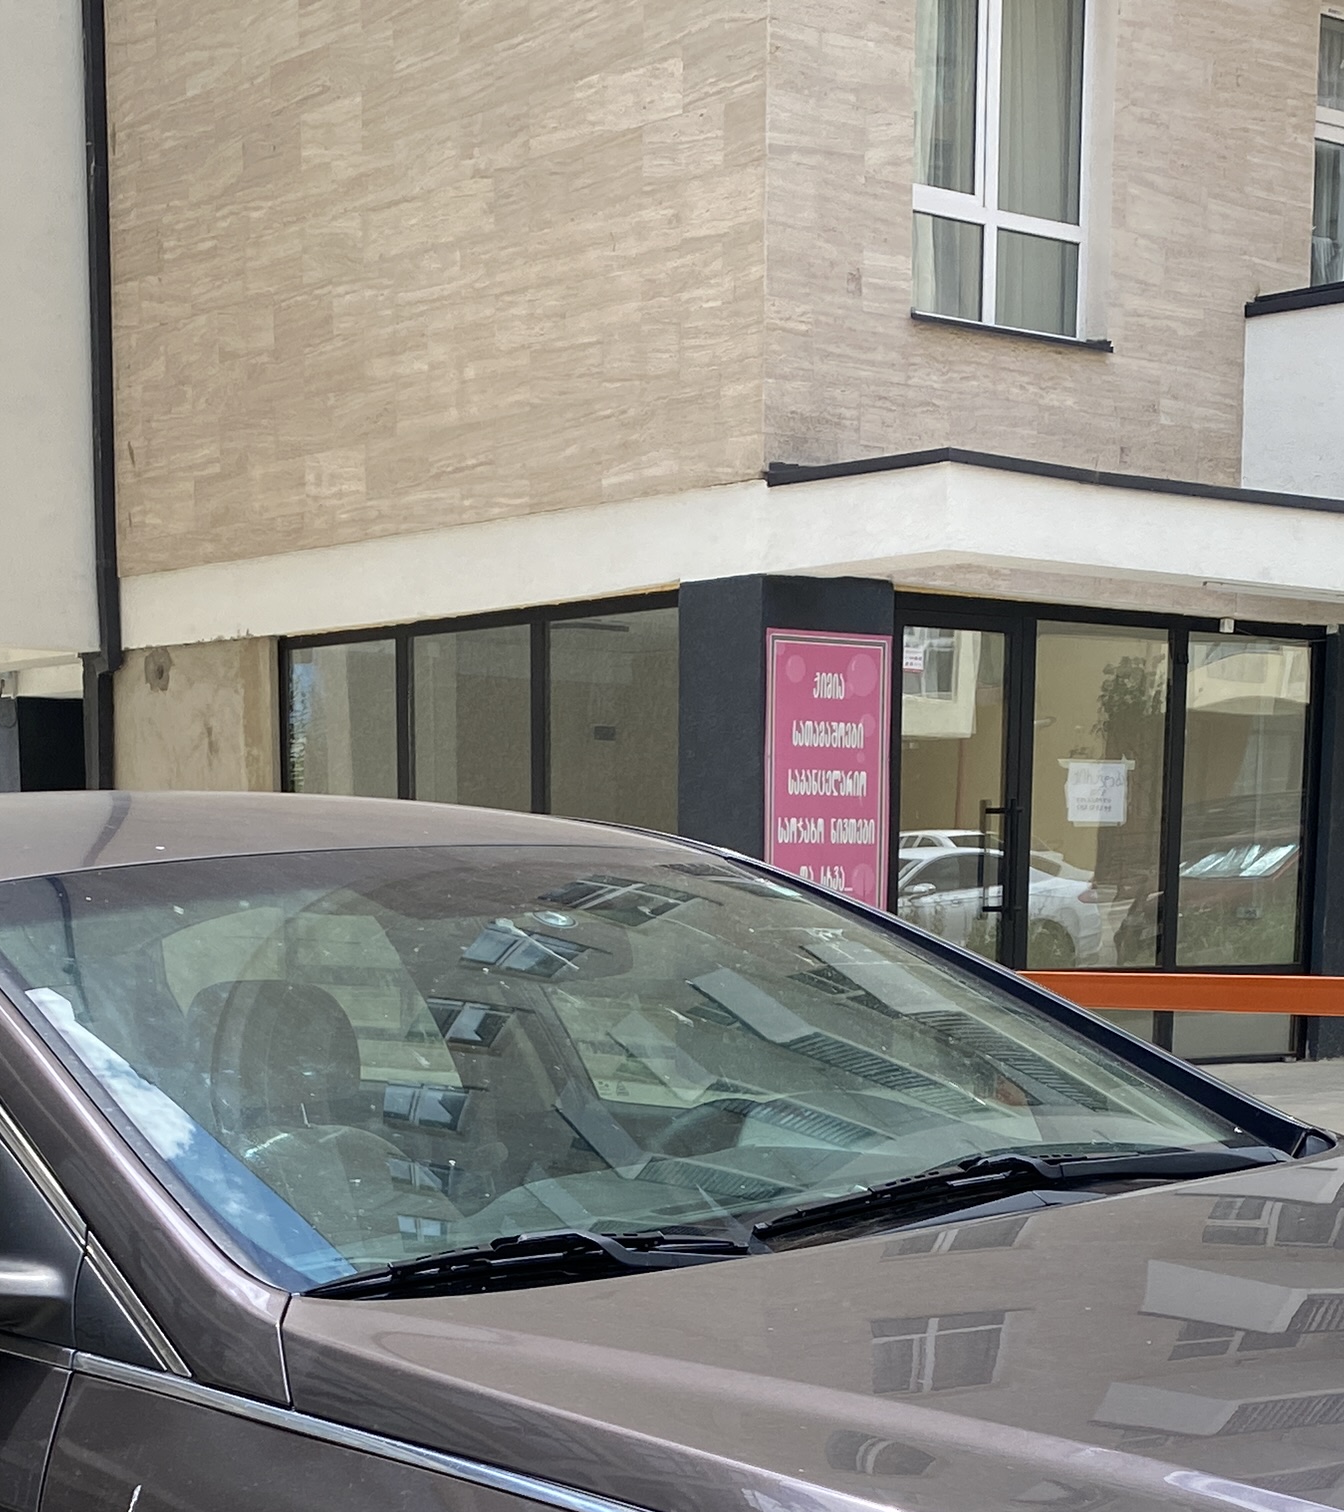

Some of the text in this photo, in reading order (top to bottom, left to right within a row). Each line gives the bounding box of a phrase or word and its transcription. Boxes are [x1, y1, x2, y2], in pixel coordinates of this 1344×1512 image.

[813, 672, 845, 700] ქიმია
[792, 720, 864, 749] სათამაშოები
[787, 768, 867, 797] საკანცელარიო
[777, 816, 875, 845] საოჯახო ნივთები
